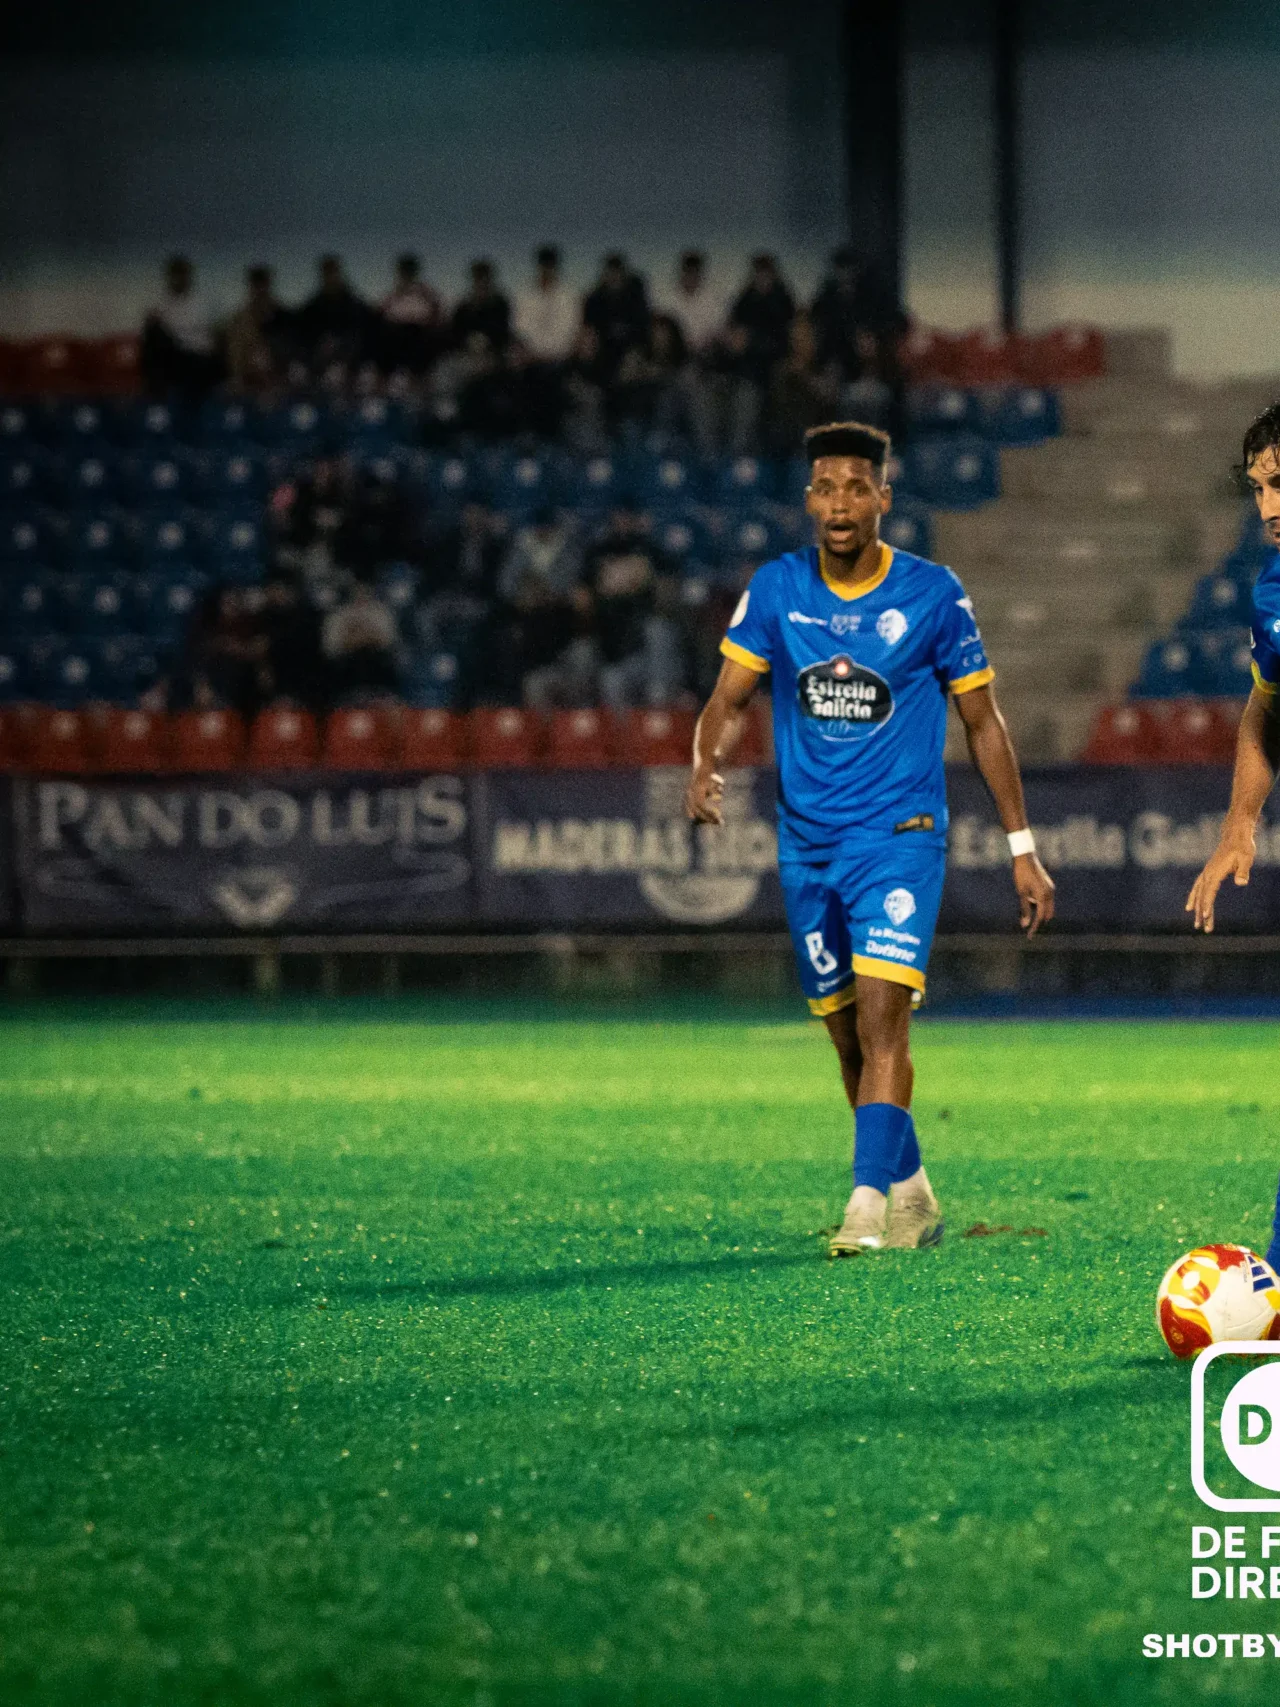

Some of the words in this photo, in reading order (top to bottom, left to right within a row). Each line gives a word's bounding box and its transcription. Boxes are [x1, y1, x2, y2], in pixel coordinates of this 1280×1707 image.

[806, 676, 877, 702] Estrella
[809, 695, 873, 719] Galicia
[36, 780, 185, 850] PAN
[200, 788, 302, 850] DO
[310, 774, 467, 850] LUIS
[950, 815, 1126, 866] Esella
